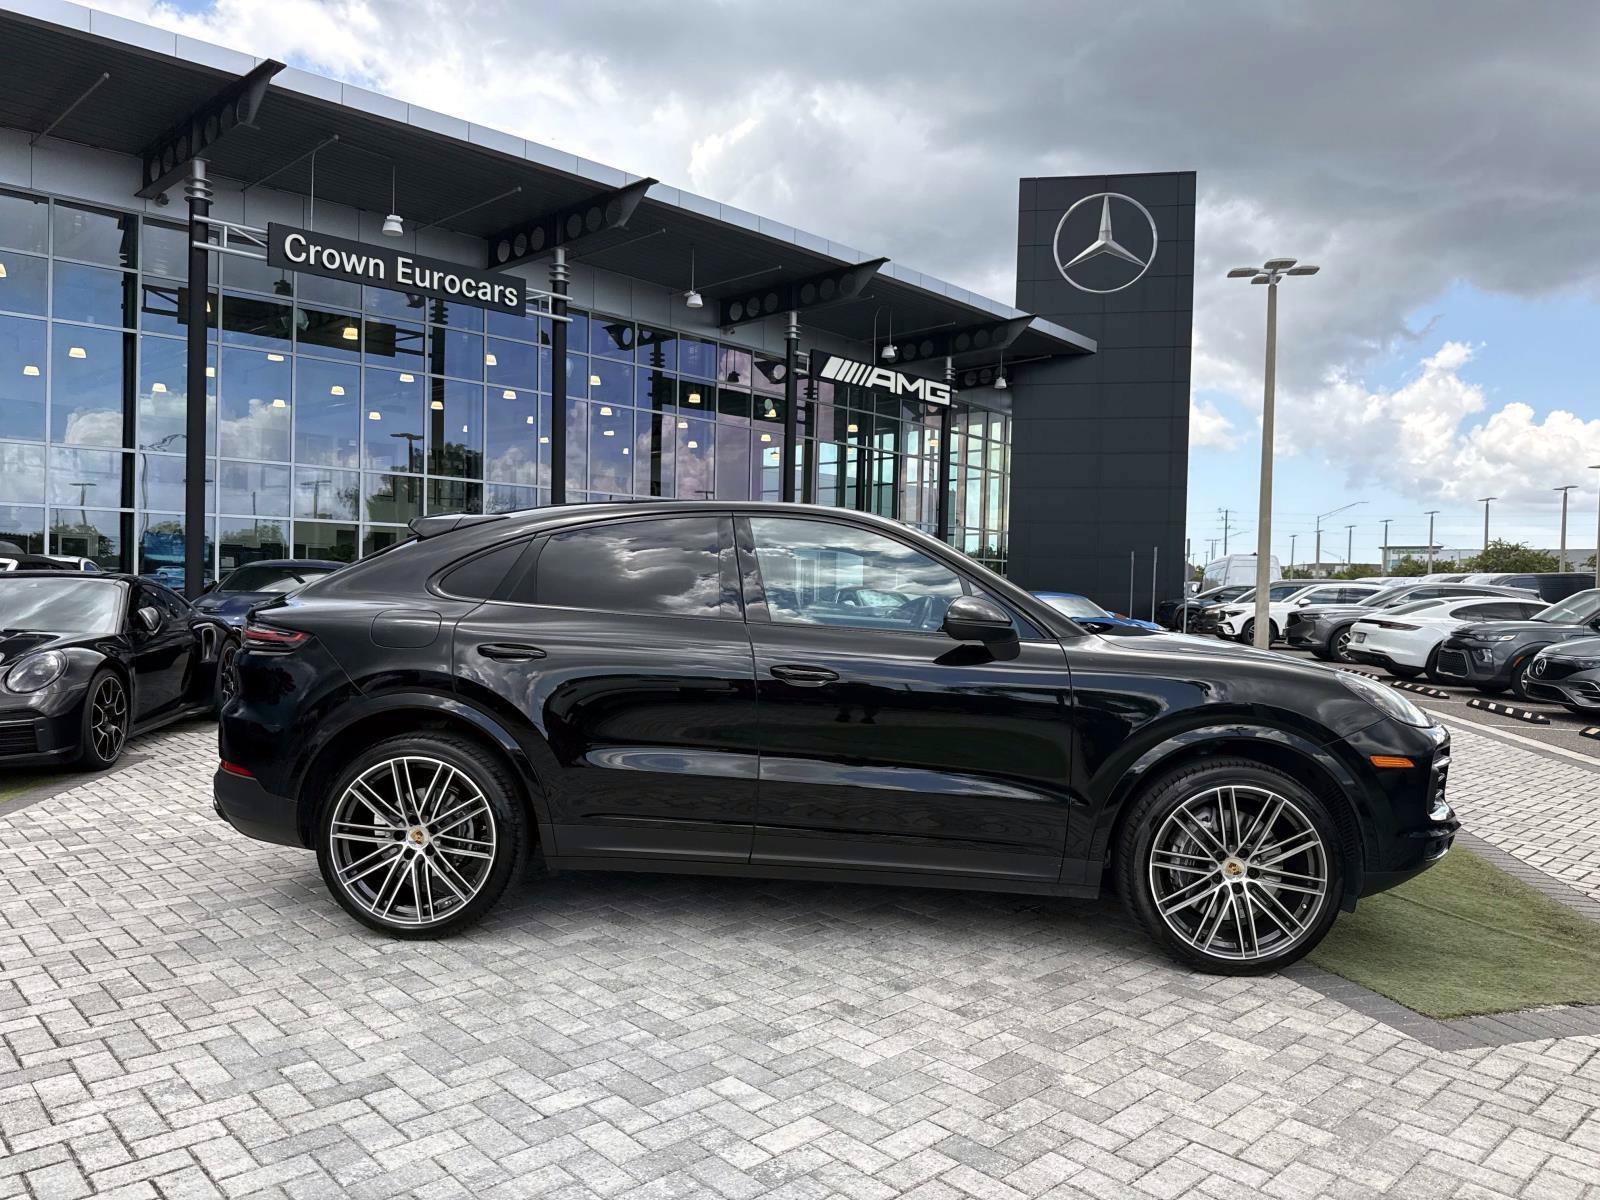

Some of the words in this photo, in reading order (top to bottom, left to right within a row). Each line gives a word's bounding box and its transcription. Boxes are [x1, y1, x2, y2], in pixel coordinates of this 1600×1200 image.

[284, 233, 384, 279] Crown
[397, 256, 518, 307] Eurocars
[864, 366, 951, 406] AMG
